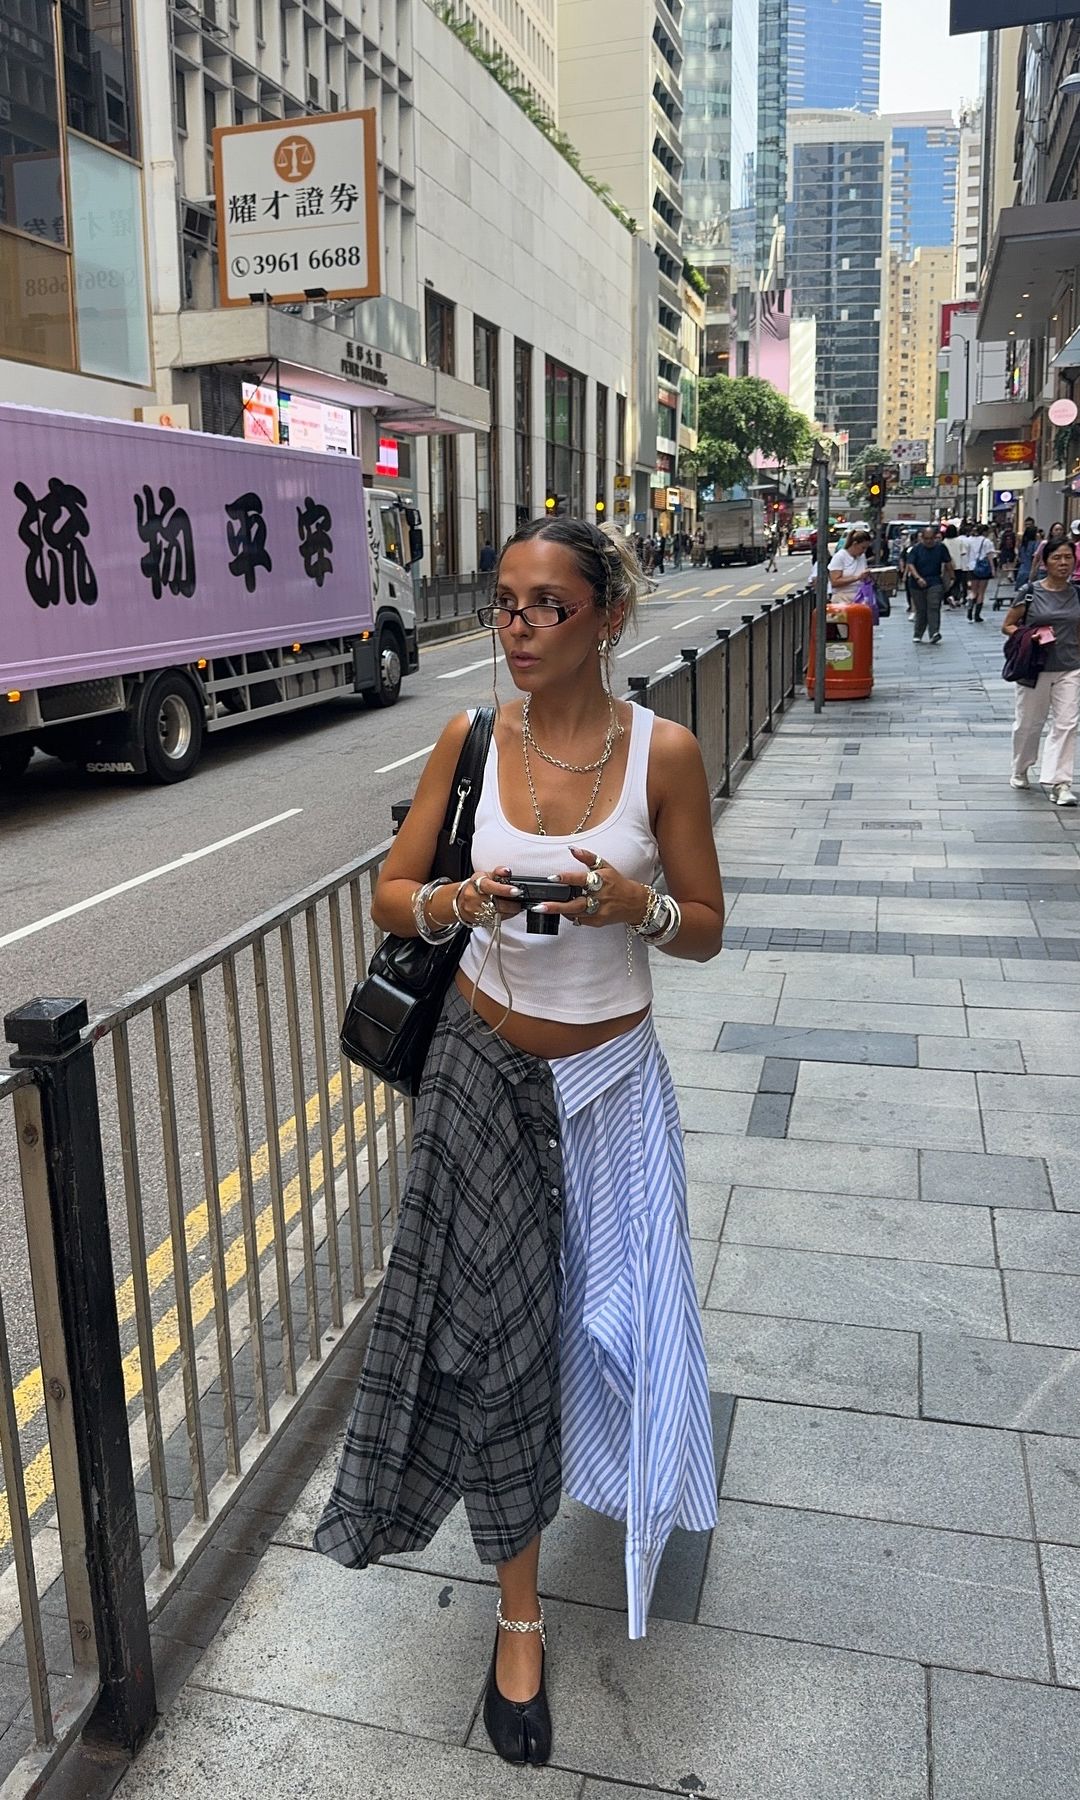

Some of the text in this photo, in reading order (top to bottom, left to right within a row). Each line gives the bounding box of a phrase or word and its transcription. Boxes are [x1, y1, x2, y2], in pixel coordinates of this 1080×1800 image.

[229, 183, 359, 224] 耀才證券
[253, 246, 361, 275] 3961 6688
[14, 477, 333, 608] 流物平安
[86, 762, 135, 772] SCANIA
